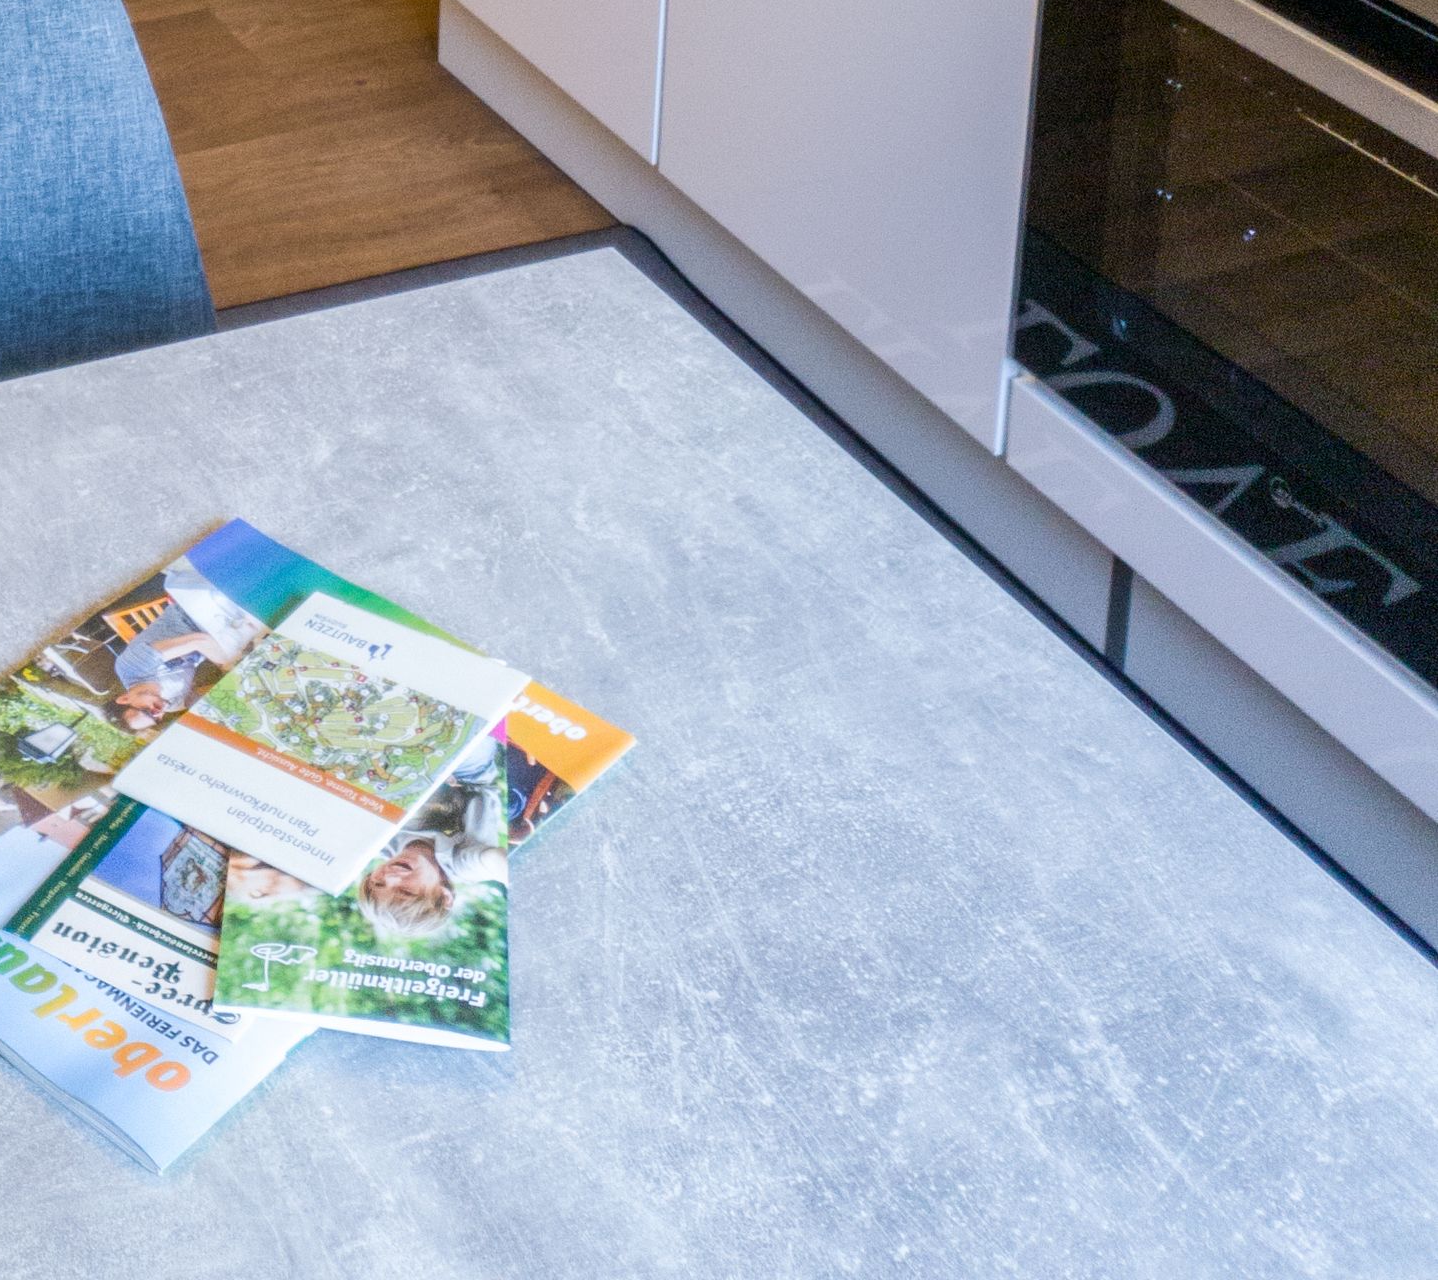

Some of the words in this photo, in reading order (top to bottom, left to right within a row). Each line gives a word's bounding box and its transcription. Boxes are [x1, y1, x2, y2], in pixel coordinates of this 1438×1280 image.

[304, 620, 367, 649] BAUTZEN
[511, 696, 586, 740] oberl
[299, 767, 323, 783] Gute
[359, 796, 384, 813] Viele
[226, 806, 335, 867] Innenstadtplan
[287, 815, 320, 837] Plan
[51, 921, 183, 985] Pension
[342, 948, 451, 977] Oberlausitz
[303, 968, 486, 1008] Freizeitknüller
[453, 968, 486, 984] der
[183, 1035, 219, 1065] DAS
